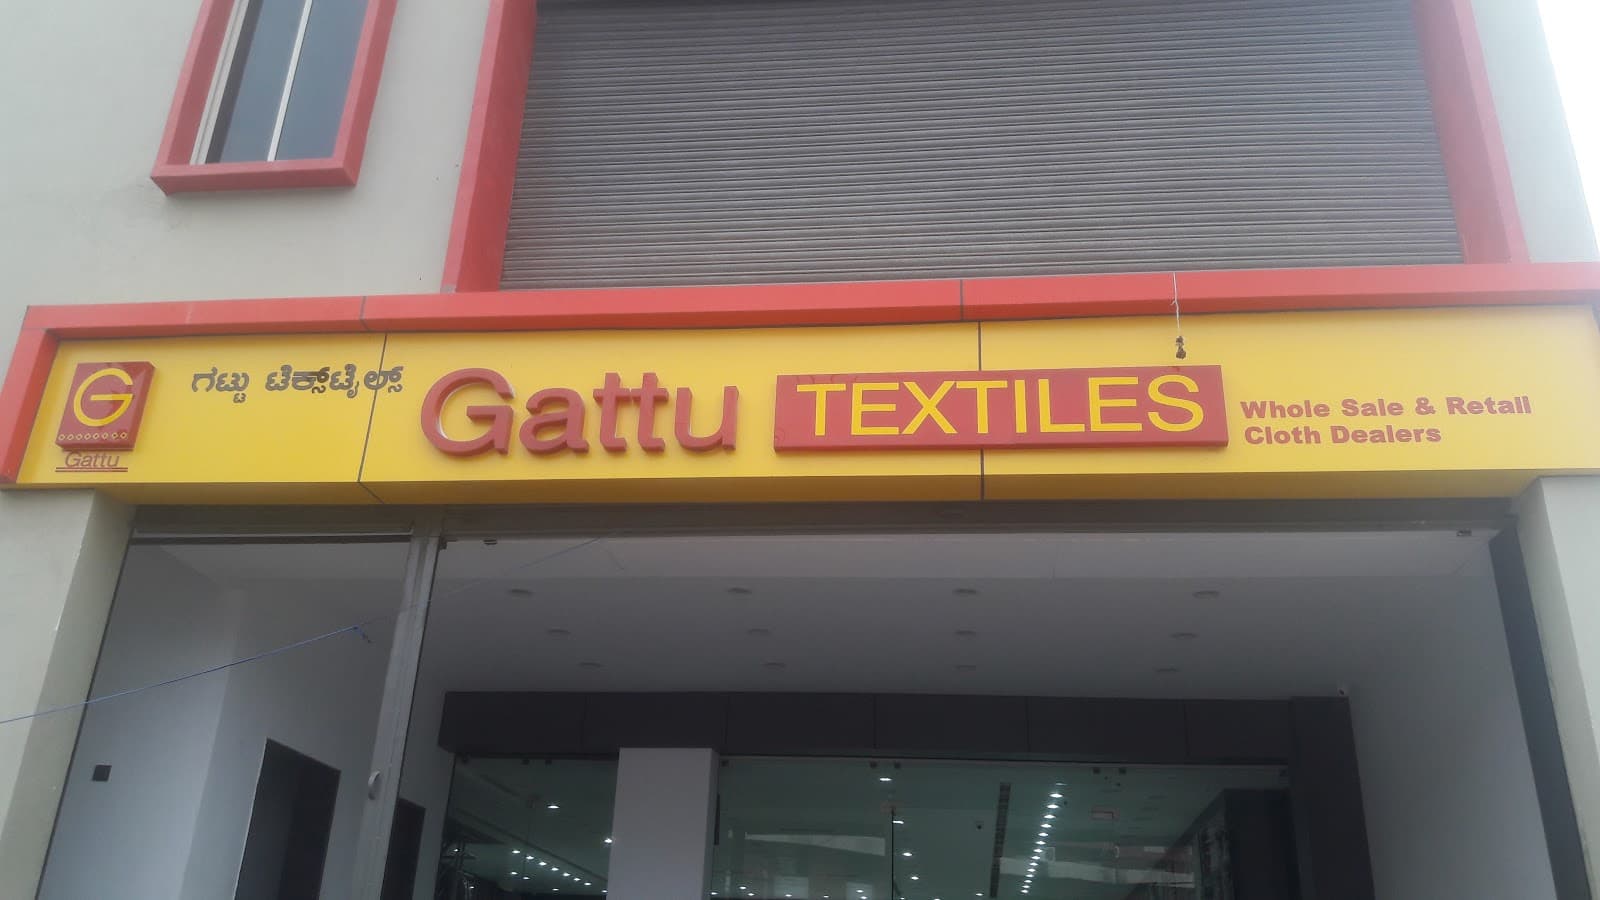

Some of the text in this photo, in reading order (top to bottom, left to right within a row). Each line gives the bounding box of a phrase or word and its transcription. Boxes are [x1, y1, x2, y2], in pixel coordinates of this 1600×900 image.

[191, 367, 250, 403] ಗಟ್ಟು
[420, 367, 739, 456] Gattu
[796, 375, 1204, 436] TEXTILES
[1240, 400, 1330, 418] Whole
[1341, 398, 1404, 417] Sale
[1415, 397, 1436, 415] &
[1244, 425, 1442, 444] Cloth Dealers
[64, 451, 120, 468] Gattu
